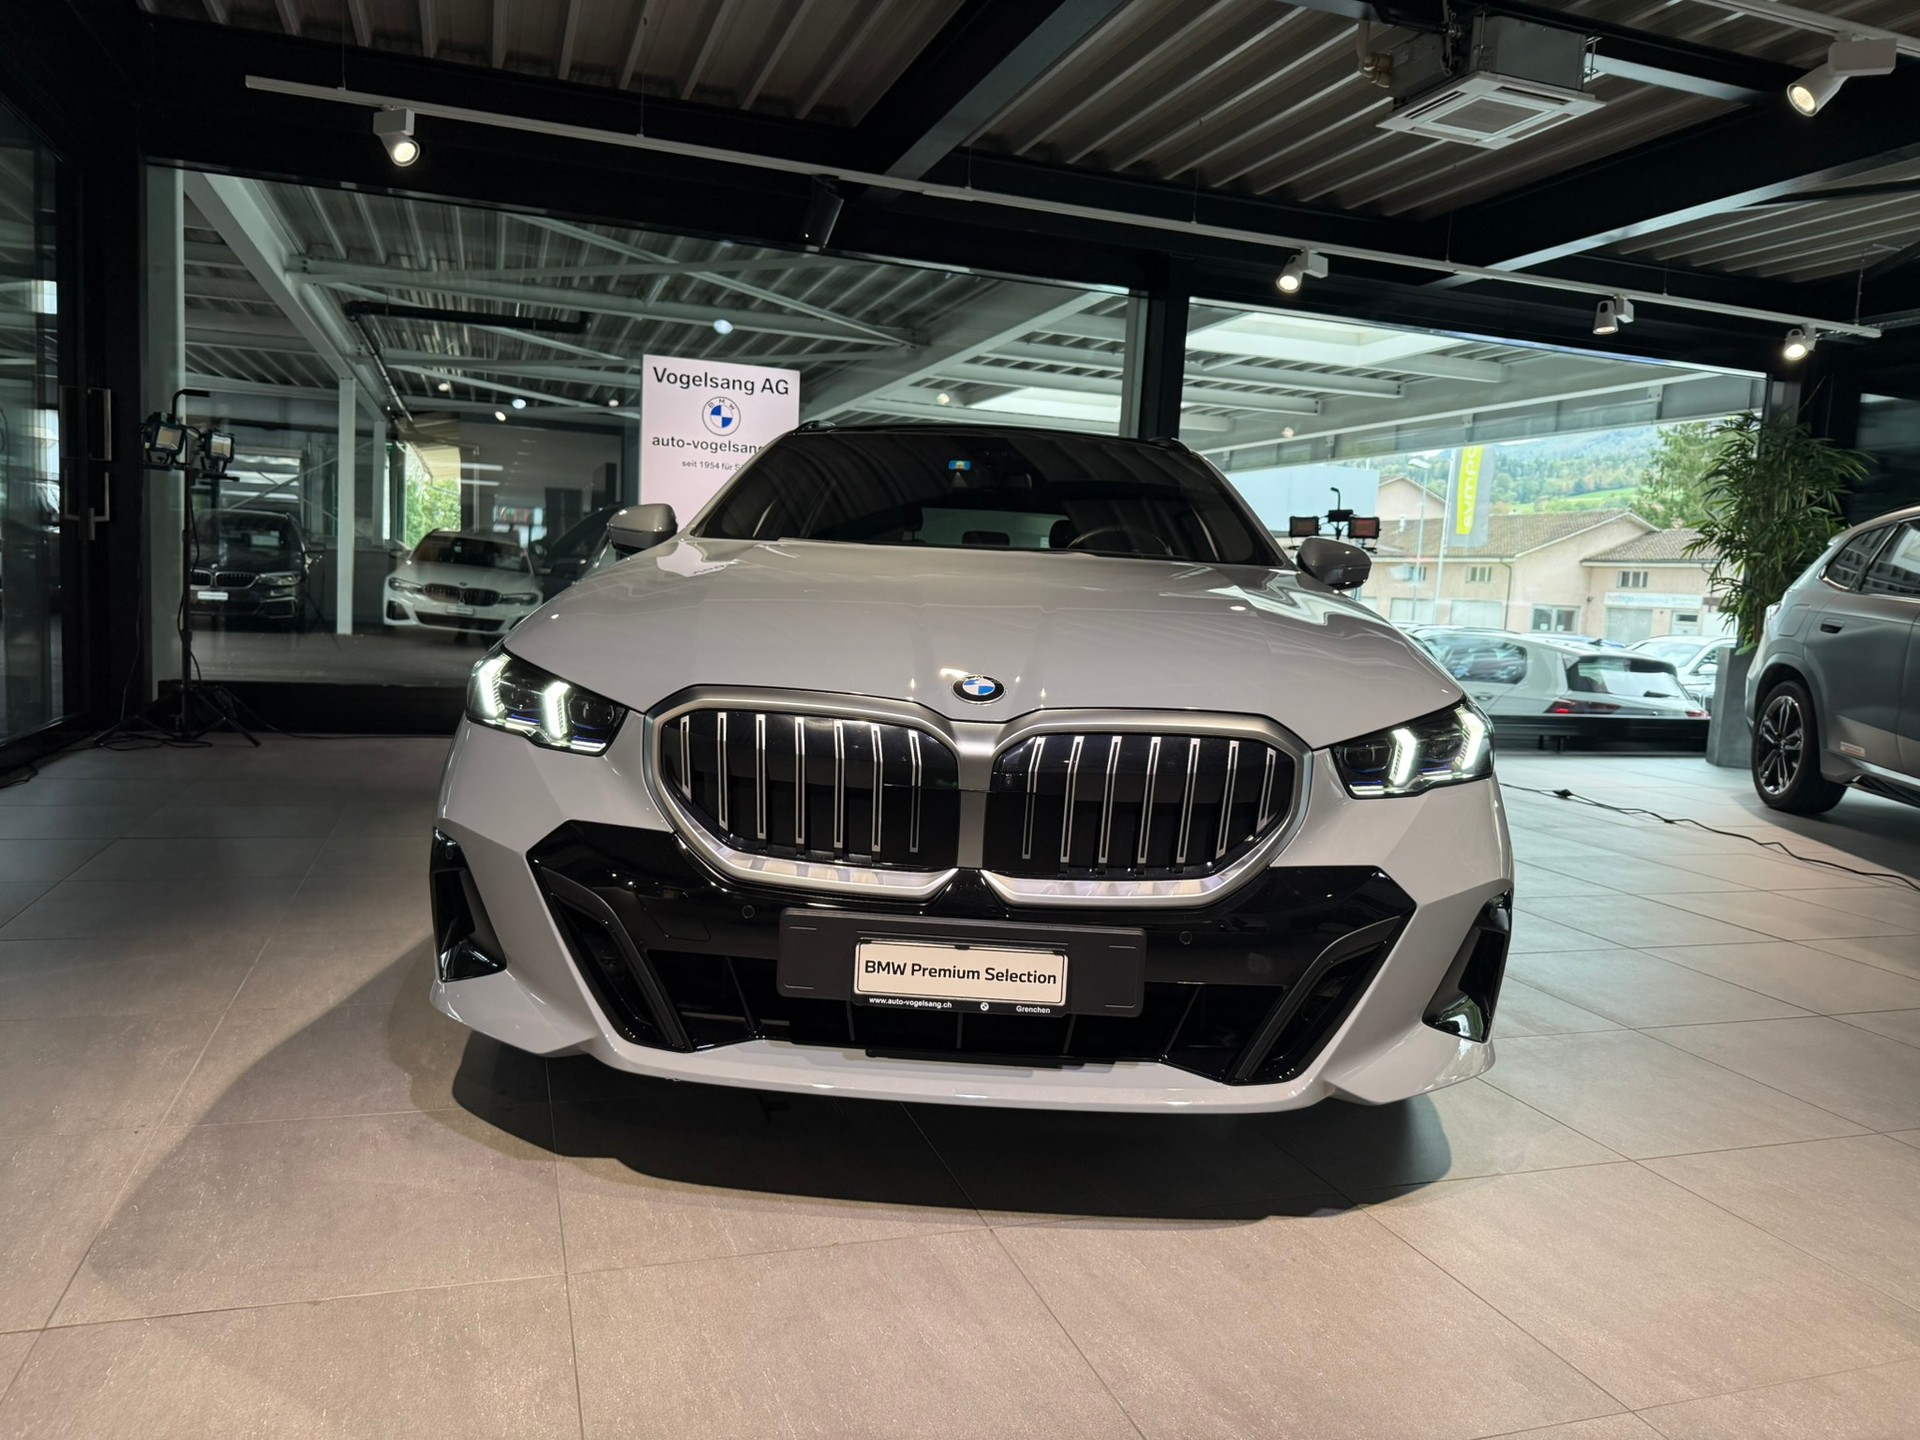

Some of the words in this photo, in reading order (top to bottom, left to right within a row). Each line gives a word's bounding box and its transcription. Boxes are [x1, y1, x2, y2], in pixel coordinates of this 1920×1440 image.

[653, 366, 755, 395] Vogelsang
[760, 378, 789, 395] AG
[682, 460, 697, 468] seit
[700, 461, 720, 469] 1954
[865, 960, 907, 976] BMW
[911, 963, 980, 980] Premium
[984, 967, 1057, 985] Selection
[869, 996, 952, 1009] www.auto-vogelsang.ch
[1016, 1005, 1050, 1014] Grenchen
